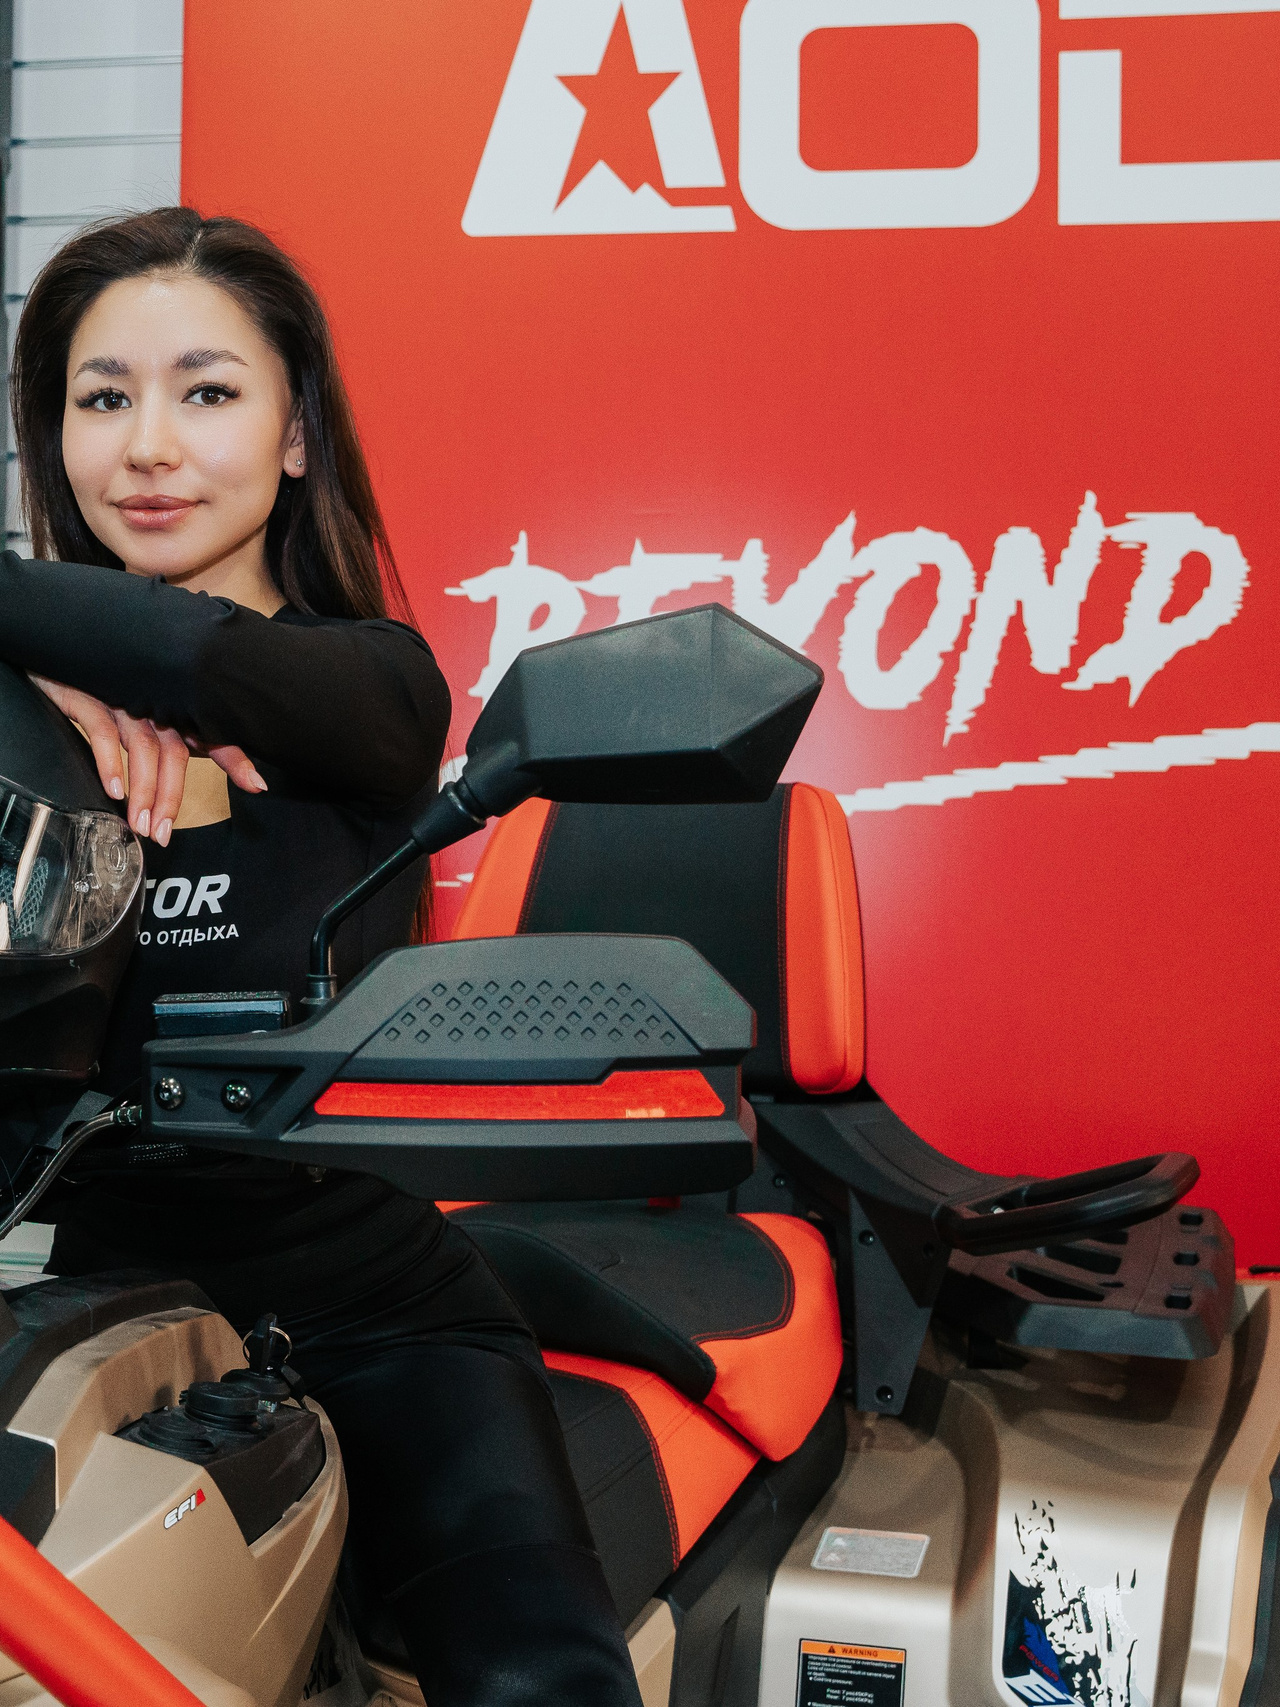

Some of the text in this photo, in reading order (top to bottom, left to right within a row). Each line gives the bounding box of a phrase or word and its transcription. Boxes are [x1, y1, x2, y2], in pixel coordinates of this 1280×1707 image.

[146, 873, 231, 919] OR
[156, 923, 239, 947] ОТДЫХА
[163, 1493, 196, 1529] EFI
[841, 1648, 878, 1657] WARNING
[1019, 1644, 1059, 1682] POWER
